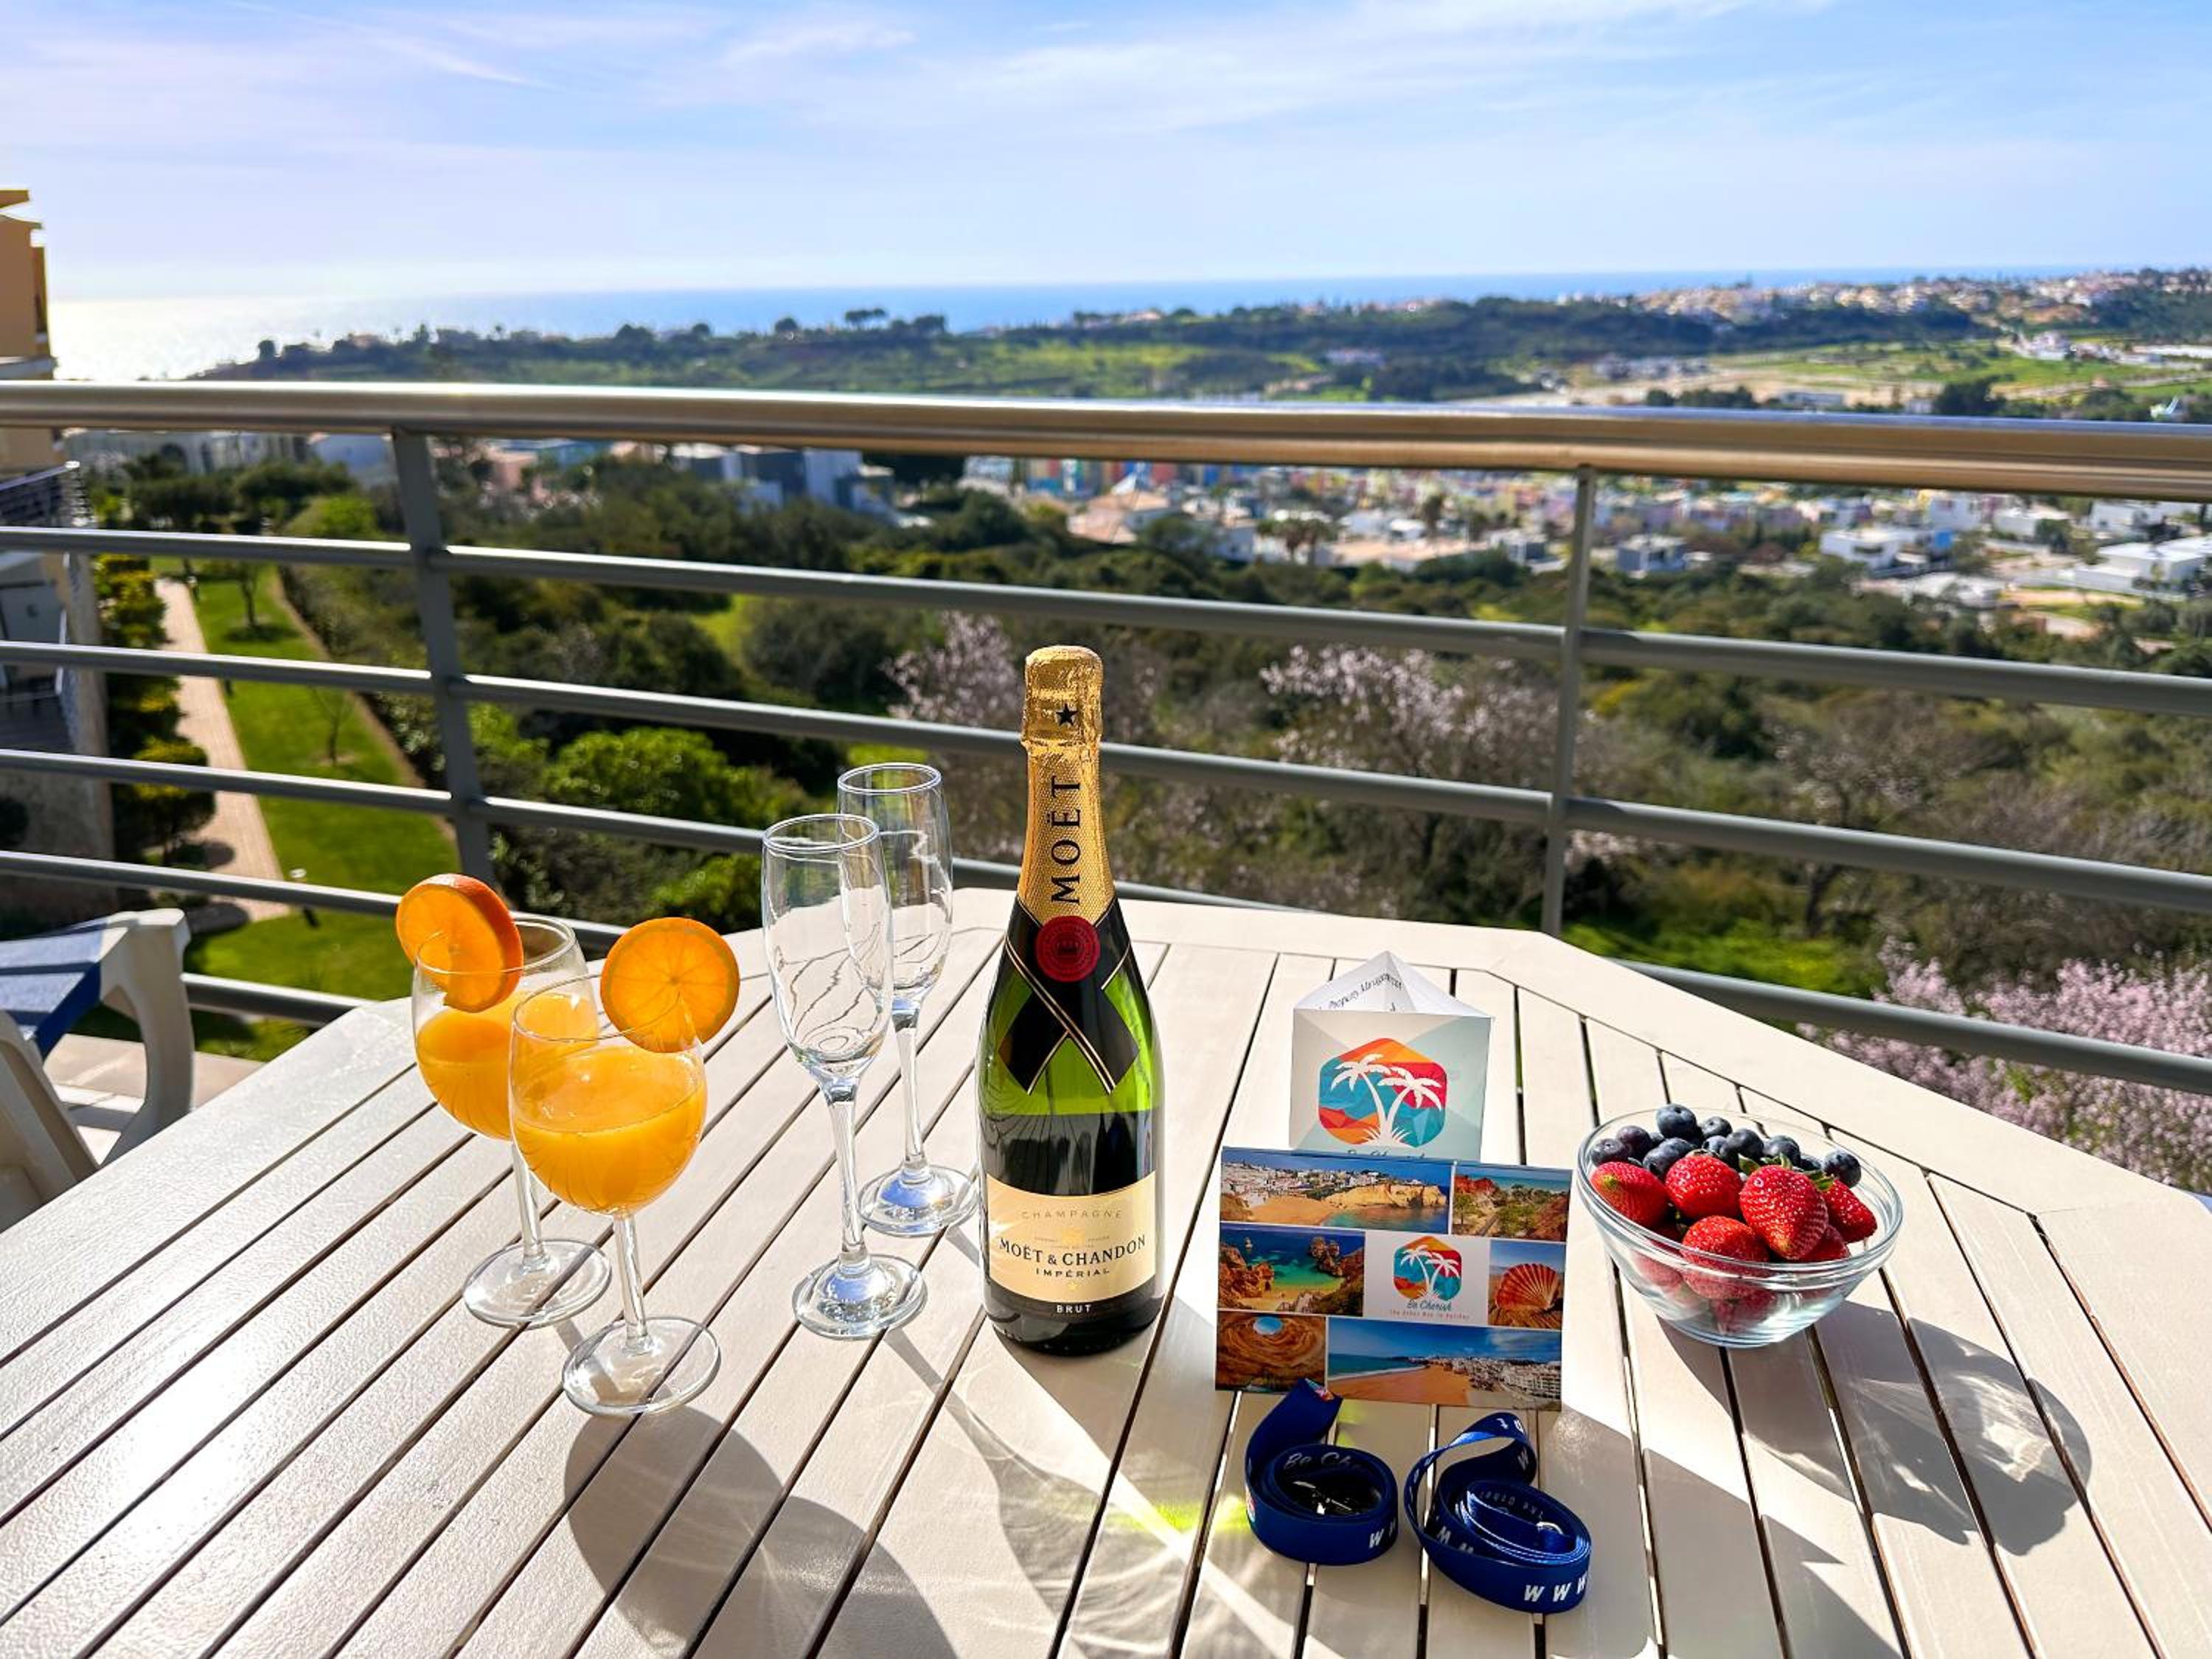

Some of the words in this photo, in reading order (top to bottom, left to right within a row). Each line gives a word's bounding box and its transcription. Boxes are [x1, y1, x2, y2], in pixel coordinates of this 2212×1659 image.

[1047, 776, 1081, 904] MOËT
[1021, 1210, 1122, 1219] CHAMPAGNE
[999, 1237, 1043, 1263] MOËT
[1047, 1254, 1057, 1265] &
[1062, 1234, 1146, 1266] CHANDON
[1036, 1267, 1110, 1278] IMPÉRIAL
[1056, 1304, 1092, 1313] BRUT
